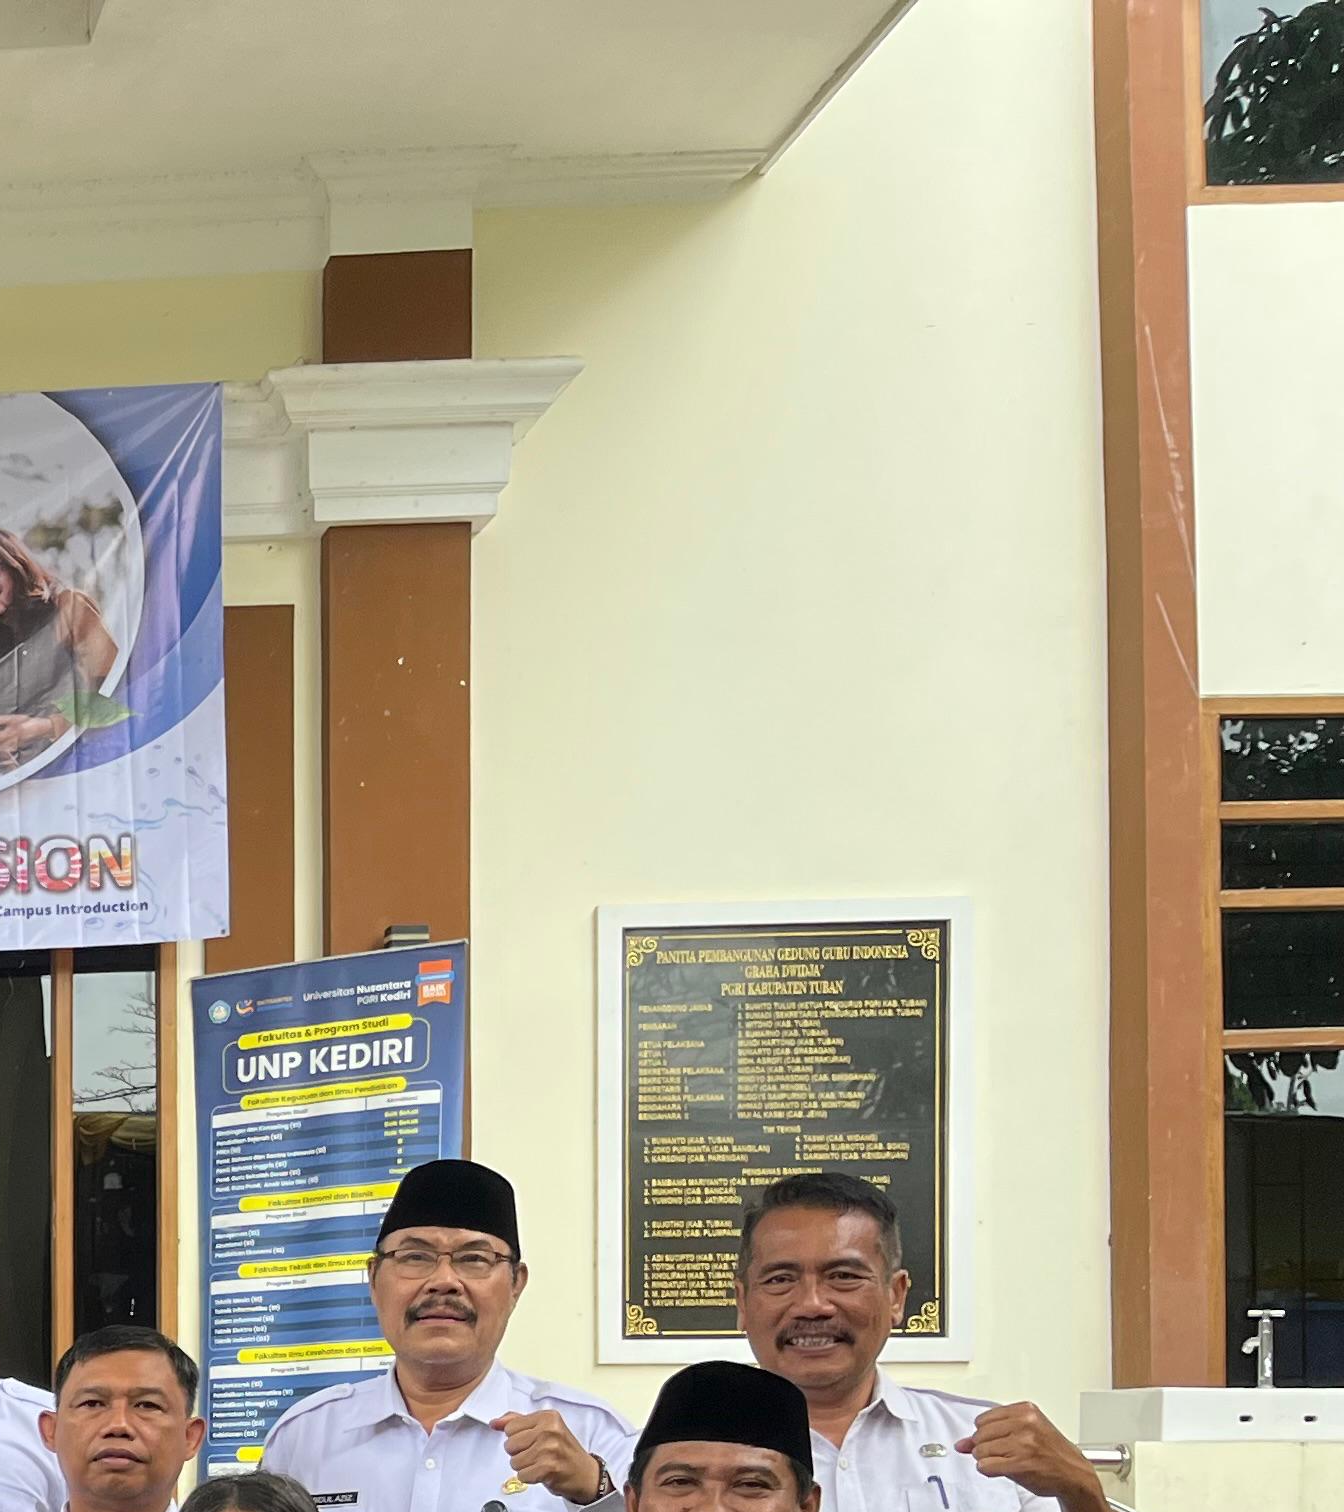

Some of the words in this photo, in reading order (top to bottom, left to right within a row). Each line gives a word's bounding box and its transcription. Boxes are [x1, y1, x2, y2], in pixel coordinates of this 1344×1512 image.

[56, 900, 149, 915] Introduction
[656, 951, 696, 964] PANITIA
[699, 949, 775, 963] PEMBANGUNAN
[778, 948, 820, 961] GEDUNG
[822, 947, 850, 960] GURU
[853, 945, 908, 960] INDONESIA
[303, 986, 354, 1001] Universitas
[356, 980, 411, 995] Nusantara
[721, 982, 745, 996] PGRI
[748, 981, 807, 995] KABUPATEN
[810, 980, 843, 994] TUBAN
[357, 994, 378, 1006] PGRI
[380, 990, 411, 1003] Kediri
[257, 1028, 302, 1043] Fakultas
[305, 1027, 312, 1037] &
[315, 1021, 359, 1036] Program
[362, 1017, 389, 1031] Studi
[237, 1052, 302, 1083] UNP
[309, 1036, 413, 1075] KEDIRI
[354, 1082, 398, 1095] Pendidikan
